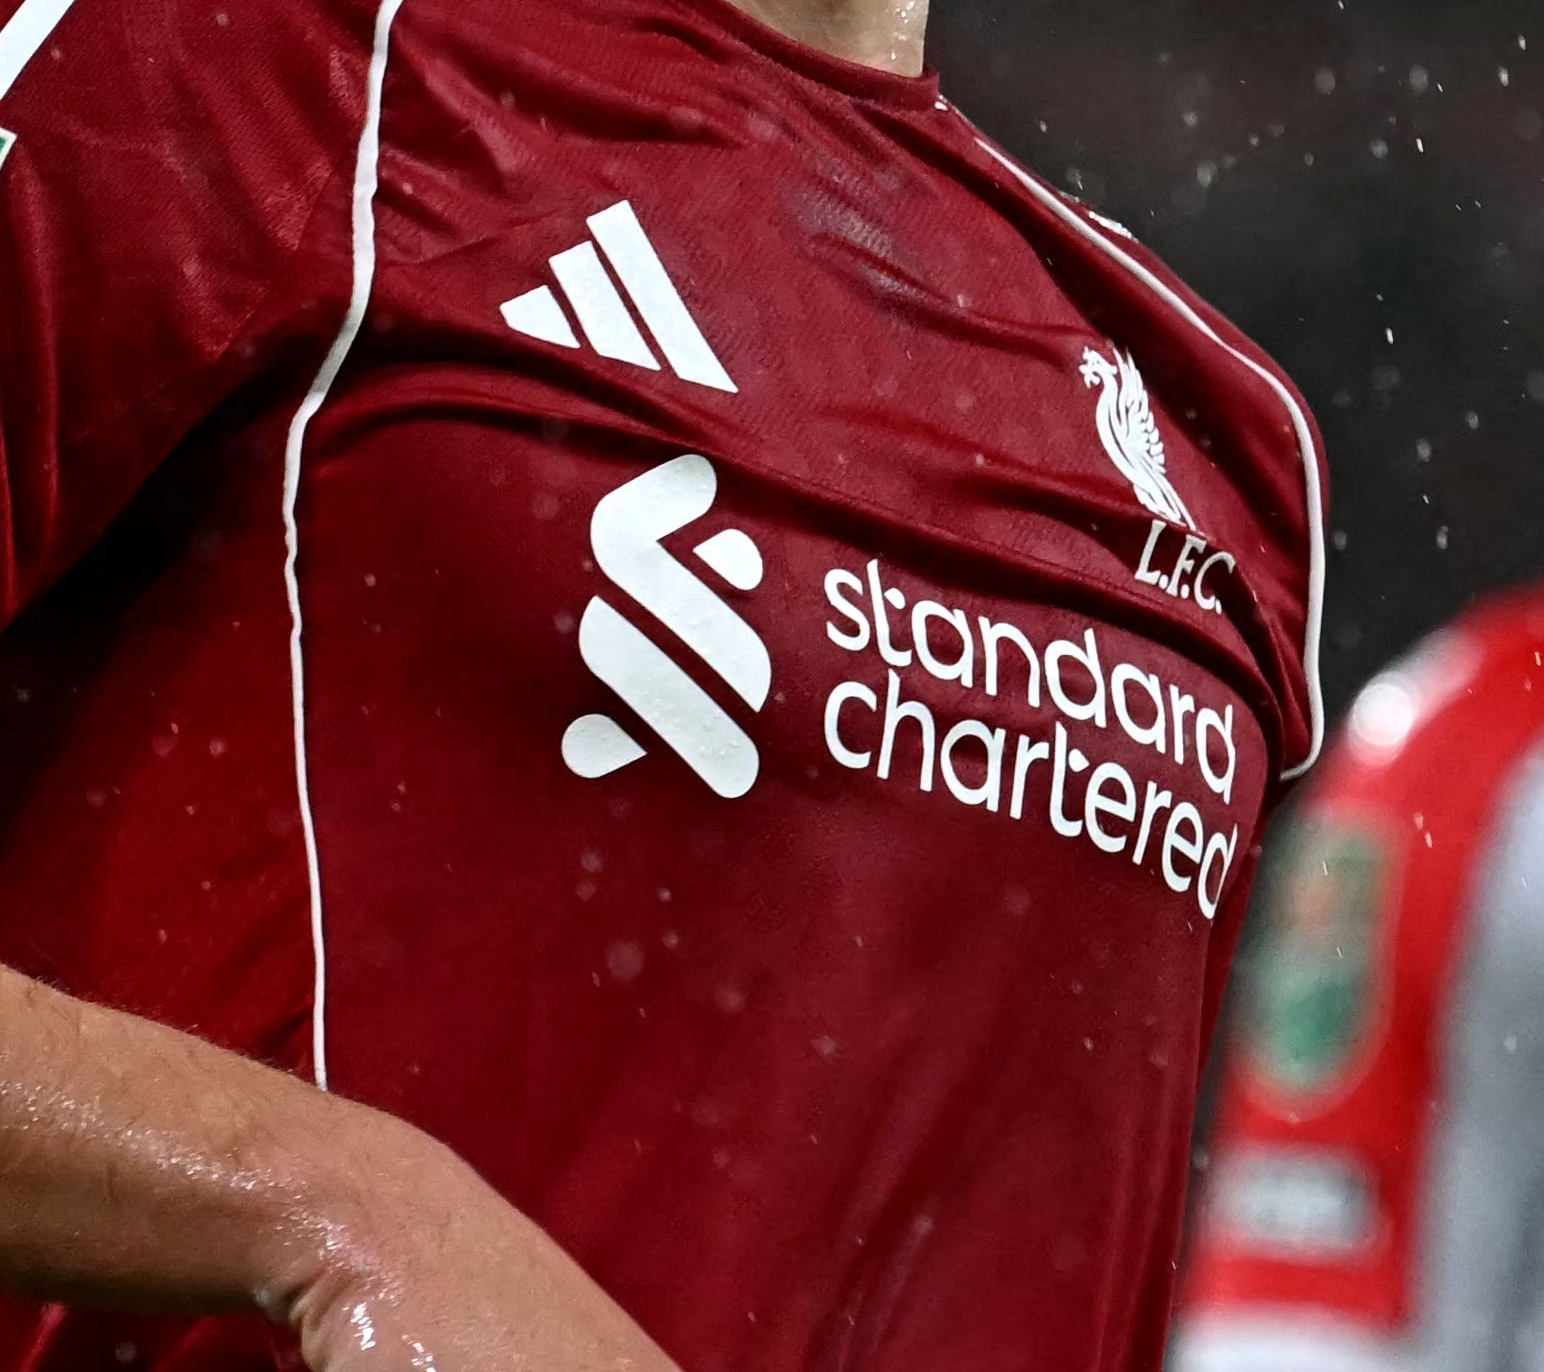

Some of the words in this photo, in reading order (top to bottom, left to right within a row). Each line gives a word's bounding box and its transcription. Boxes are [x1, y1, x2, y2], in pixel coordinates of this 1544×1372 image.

[823, 558, 1236, 805] standard
[1134, 519, 1236, 615] L.F.C.
[823, 668, 1238, 920] chartered
